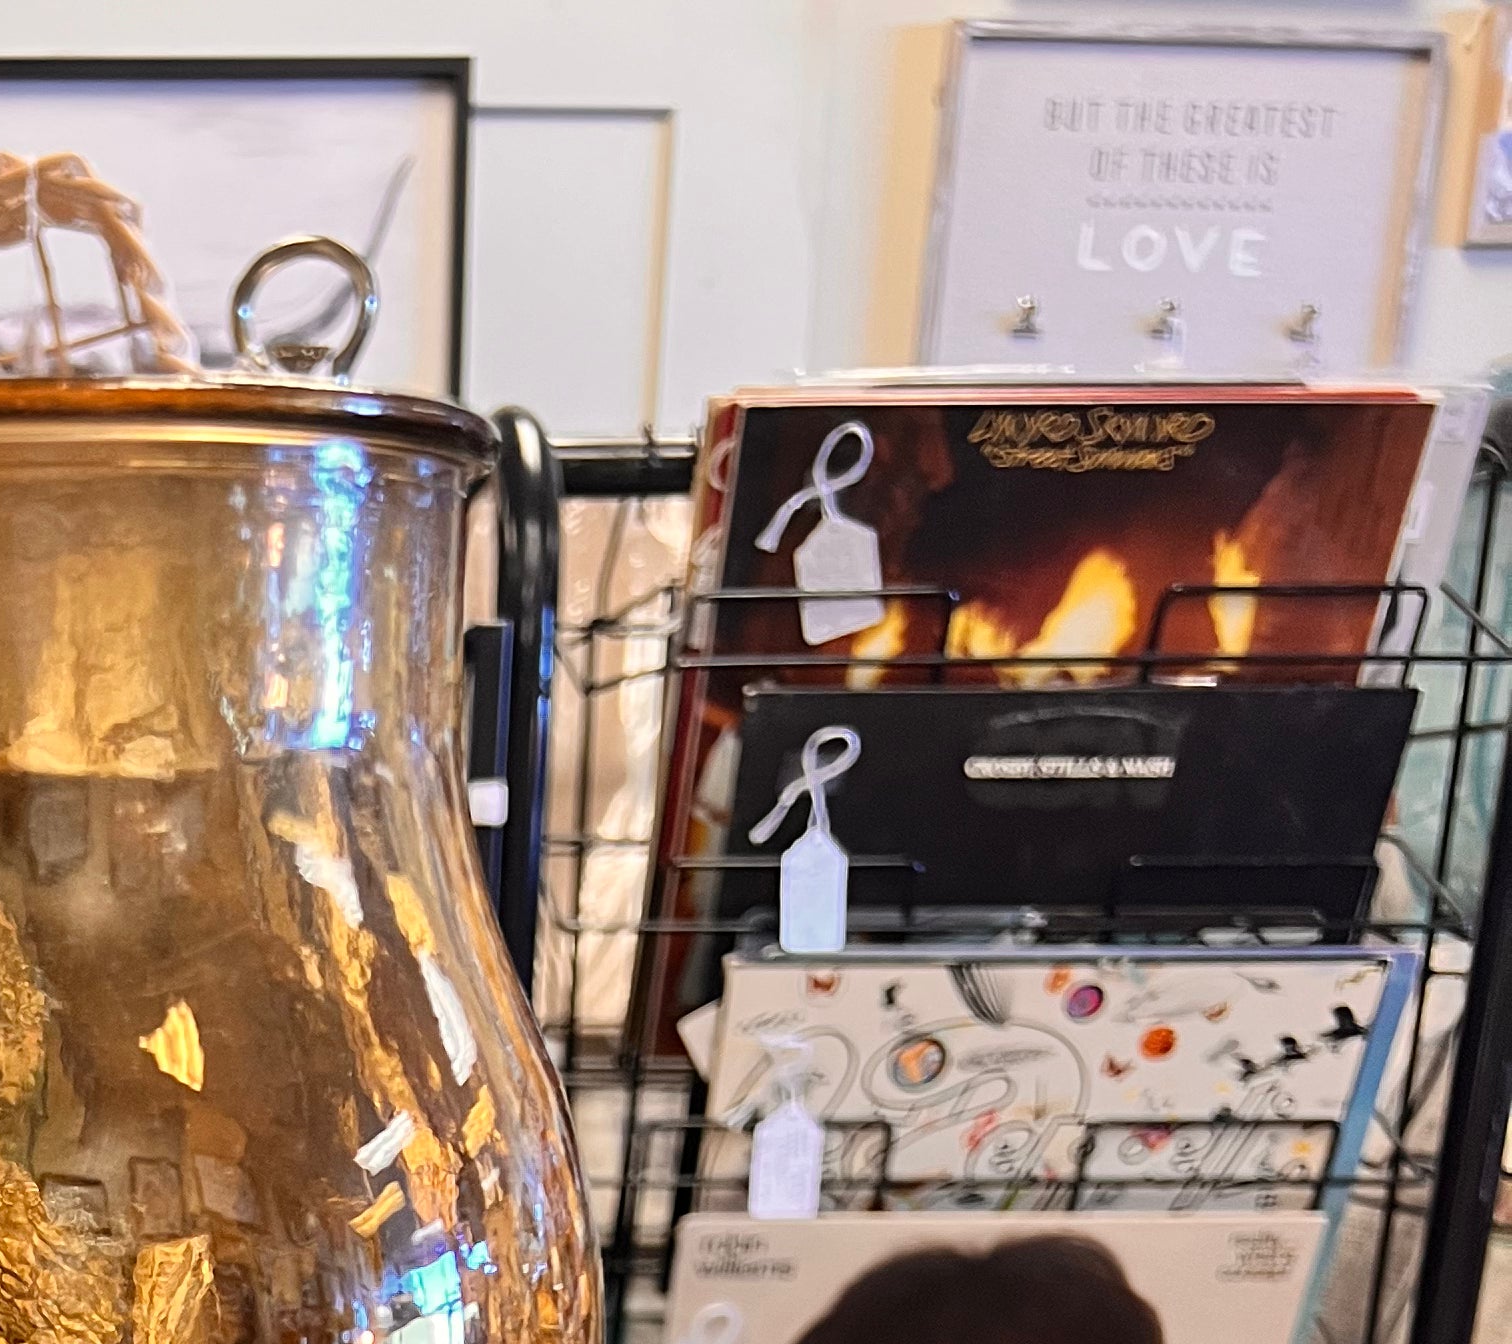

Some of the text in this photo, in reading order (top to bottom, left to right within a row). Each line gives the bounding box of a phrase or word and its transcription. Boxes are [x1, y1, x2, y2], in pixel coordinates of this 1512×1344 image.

[1044, 101, 1338, 138] BUT THE GREATEST
[1089, 150, 1279, 185] OF THESE IS
[1077, 219, 1268, 277] LOVE
